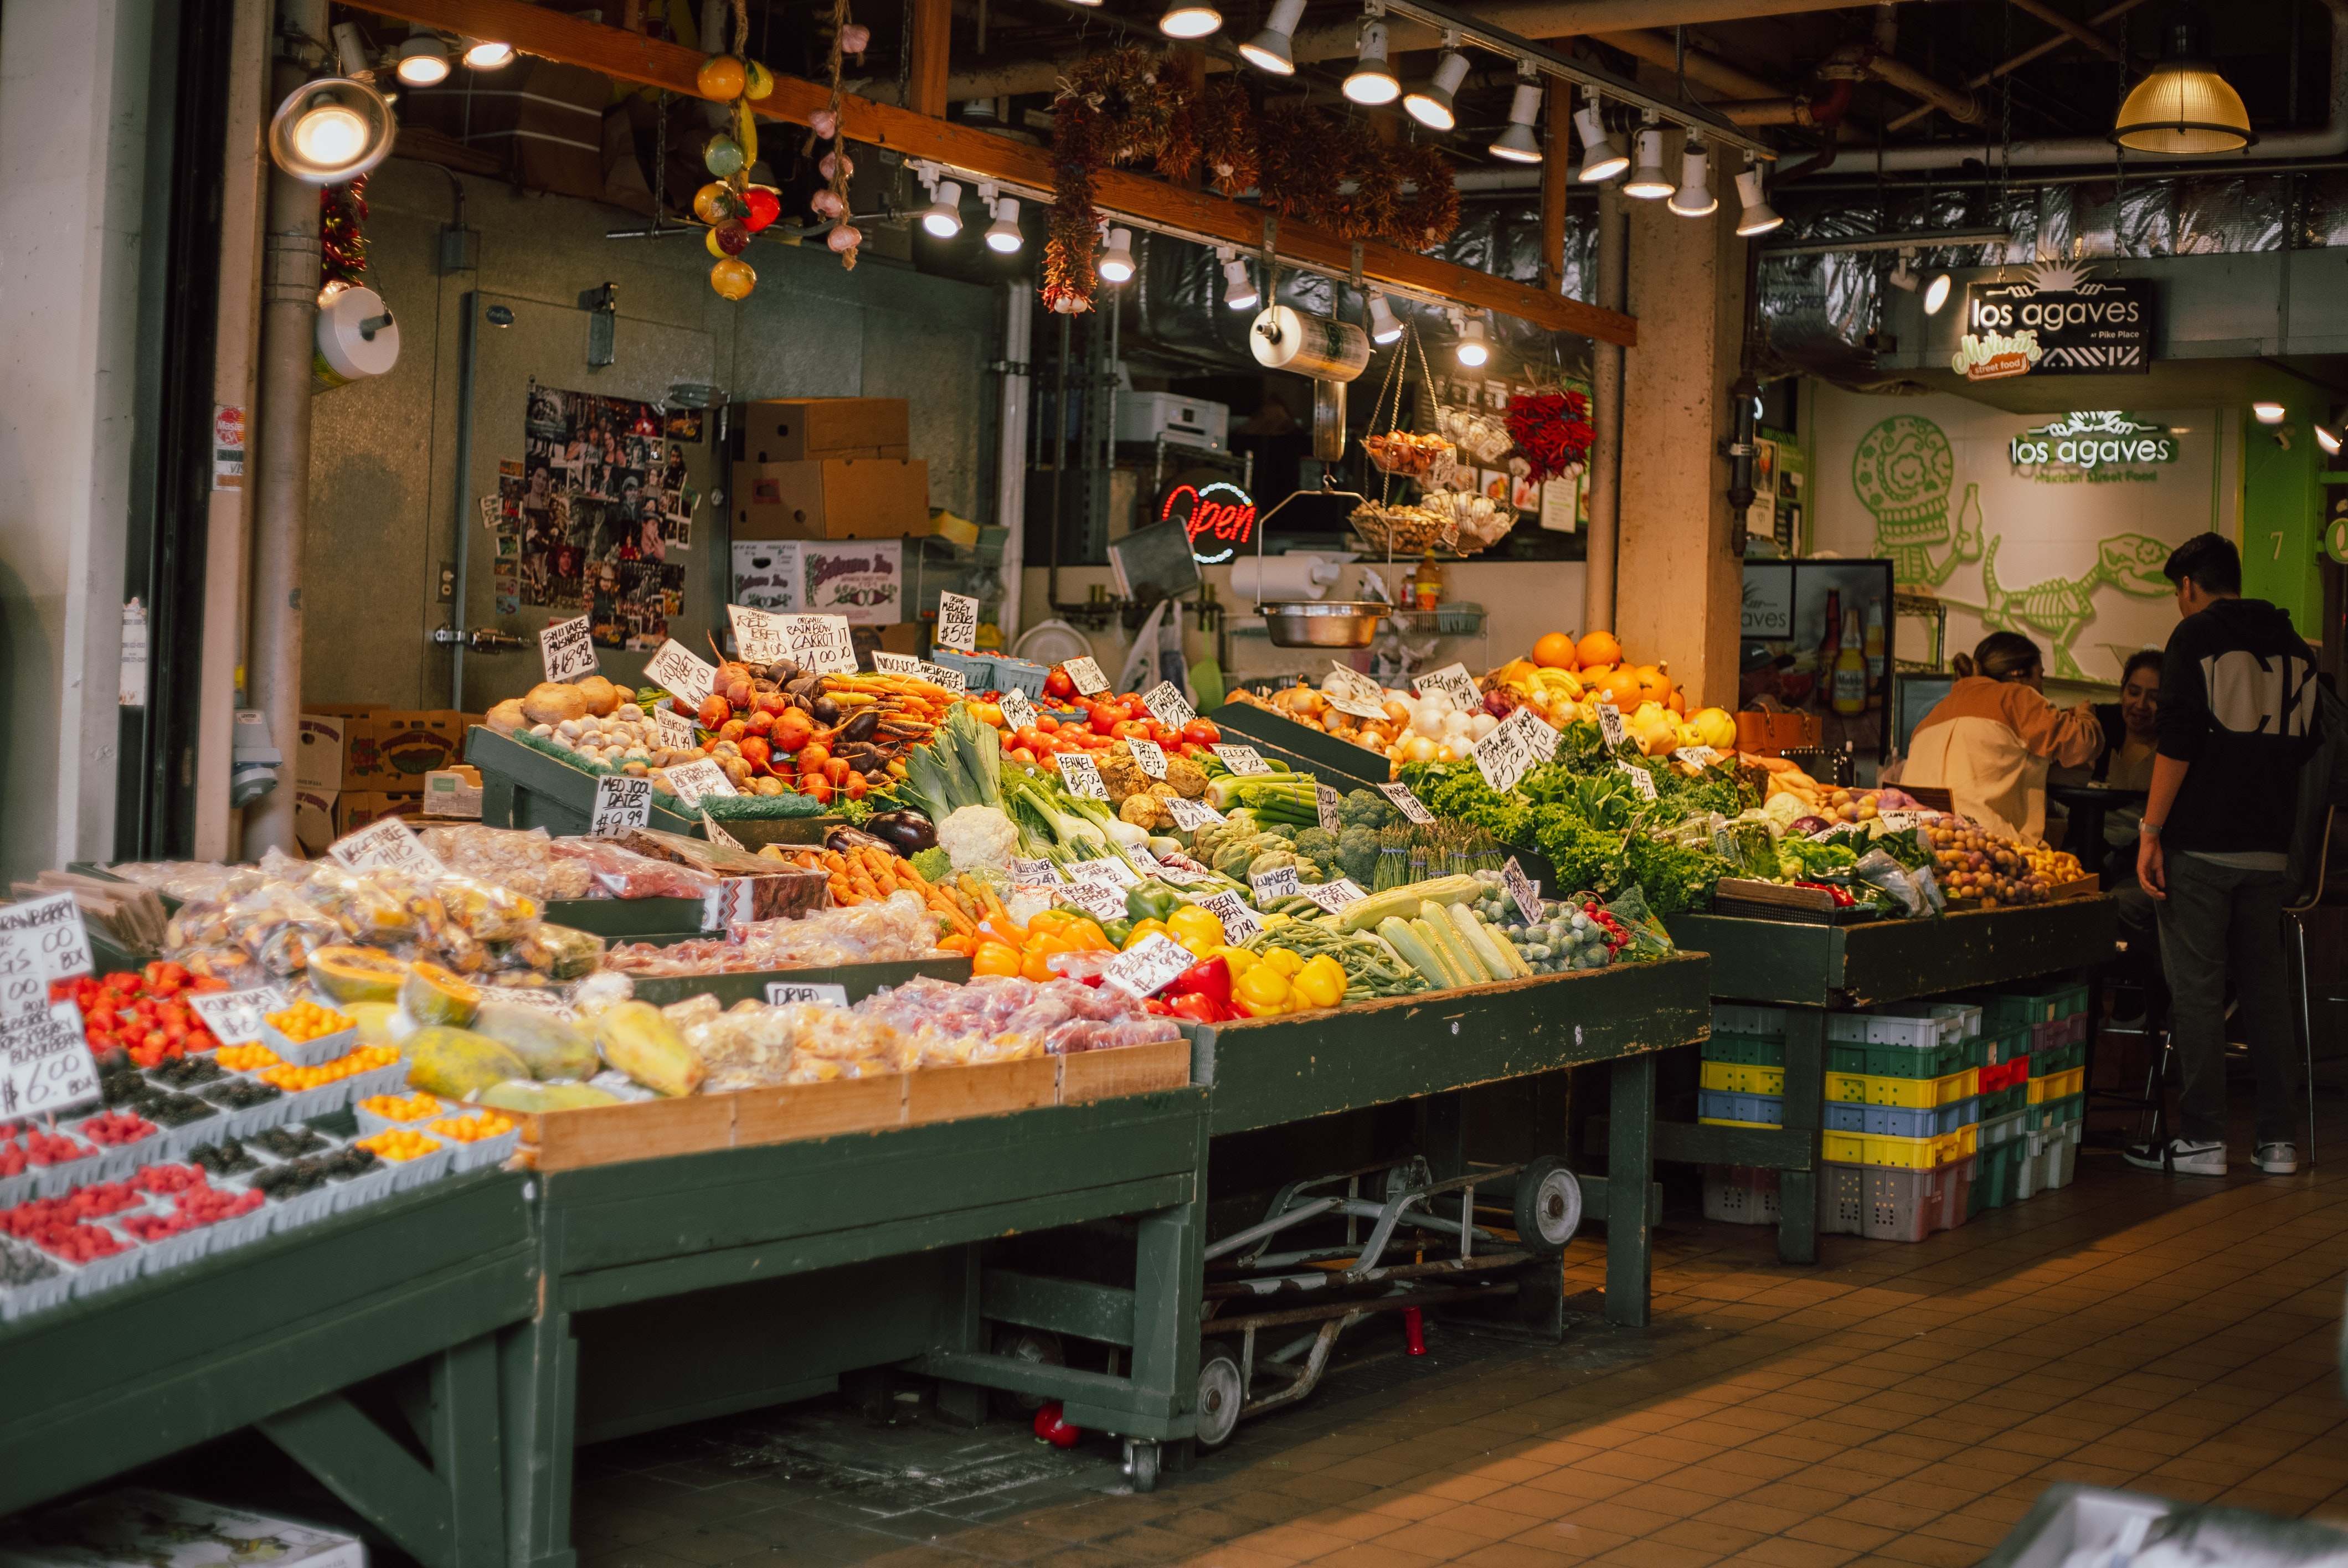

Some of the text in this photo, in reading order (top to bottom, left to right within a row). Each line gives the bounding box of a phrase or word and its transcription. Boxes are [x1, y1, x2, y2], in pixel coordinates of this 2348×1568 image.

[1973, 298, 2139, 331] los agaves
[2118, 331, 2139, 339] Place
[1975, 359, 2021, 374] street food
[2011, 436, 2170, 469] los agaves
[1162, 483, 1258, 544] Open
[942, 601, 970, 613] MEDLEY
[737, 615, 769, 628] RED
[786, 622, 832, 635] RAINBOW
[792, 632, 835, 650] CARROT
[582, 654, 594, 667] LB
[660, 653, 681, 686] GOLD
[921, 664, 963, 680] HEIRLOOM
[1419, 674, 1445, 691] RED
[658, 715, 693, 735] MUSHROOMS
[1498, 721, 1512, 739] RED
[1218, 748, 1256, 758] CELERY
[1484, 733, 1511, 763] ROMAINE
[1059, 756, 1094, 770] FENNEL
[607, 792, 644, 808] DATES
[1059, 881, 1102, 895] GREEN
[1306, 882, 1346, 898] SWEET
[1199, 893, 1237, 911] GREEN
[1319, 891, 1356, 905] CORN
[1213, 906, 1245, 924] BEAN
[60, 947, 89, 971] BOX
[9, 1031, 81, 1066] BLACKBERRY
[67, 1076, 95, 1096] BOX
